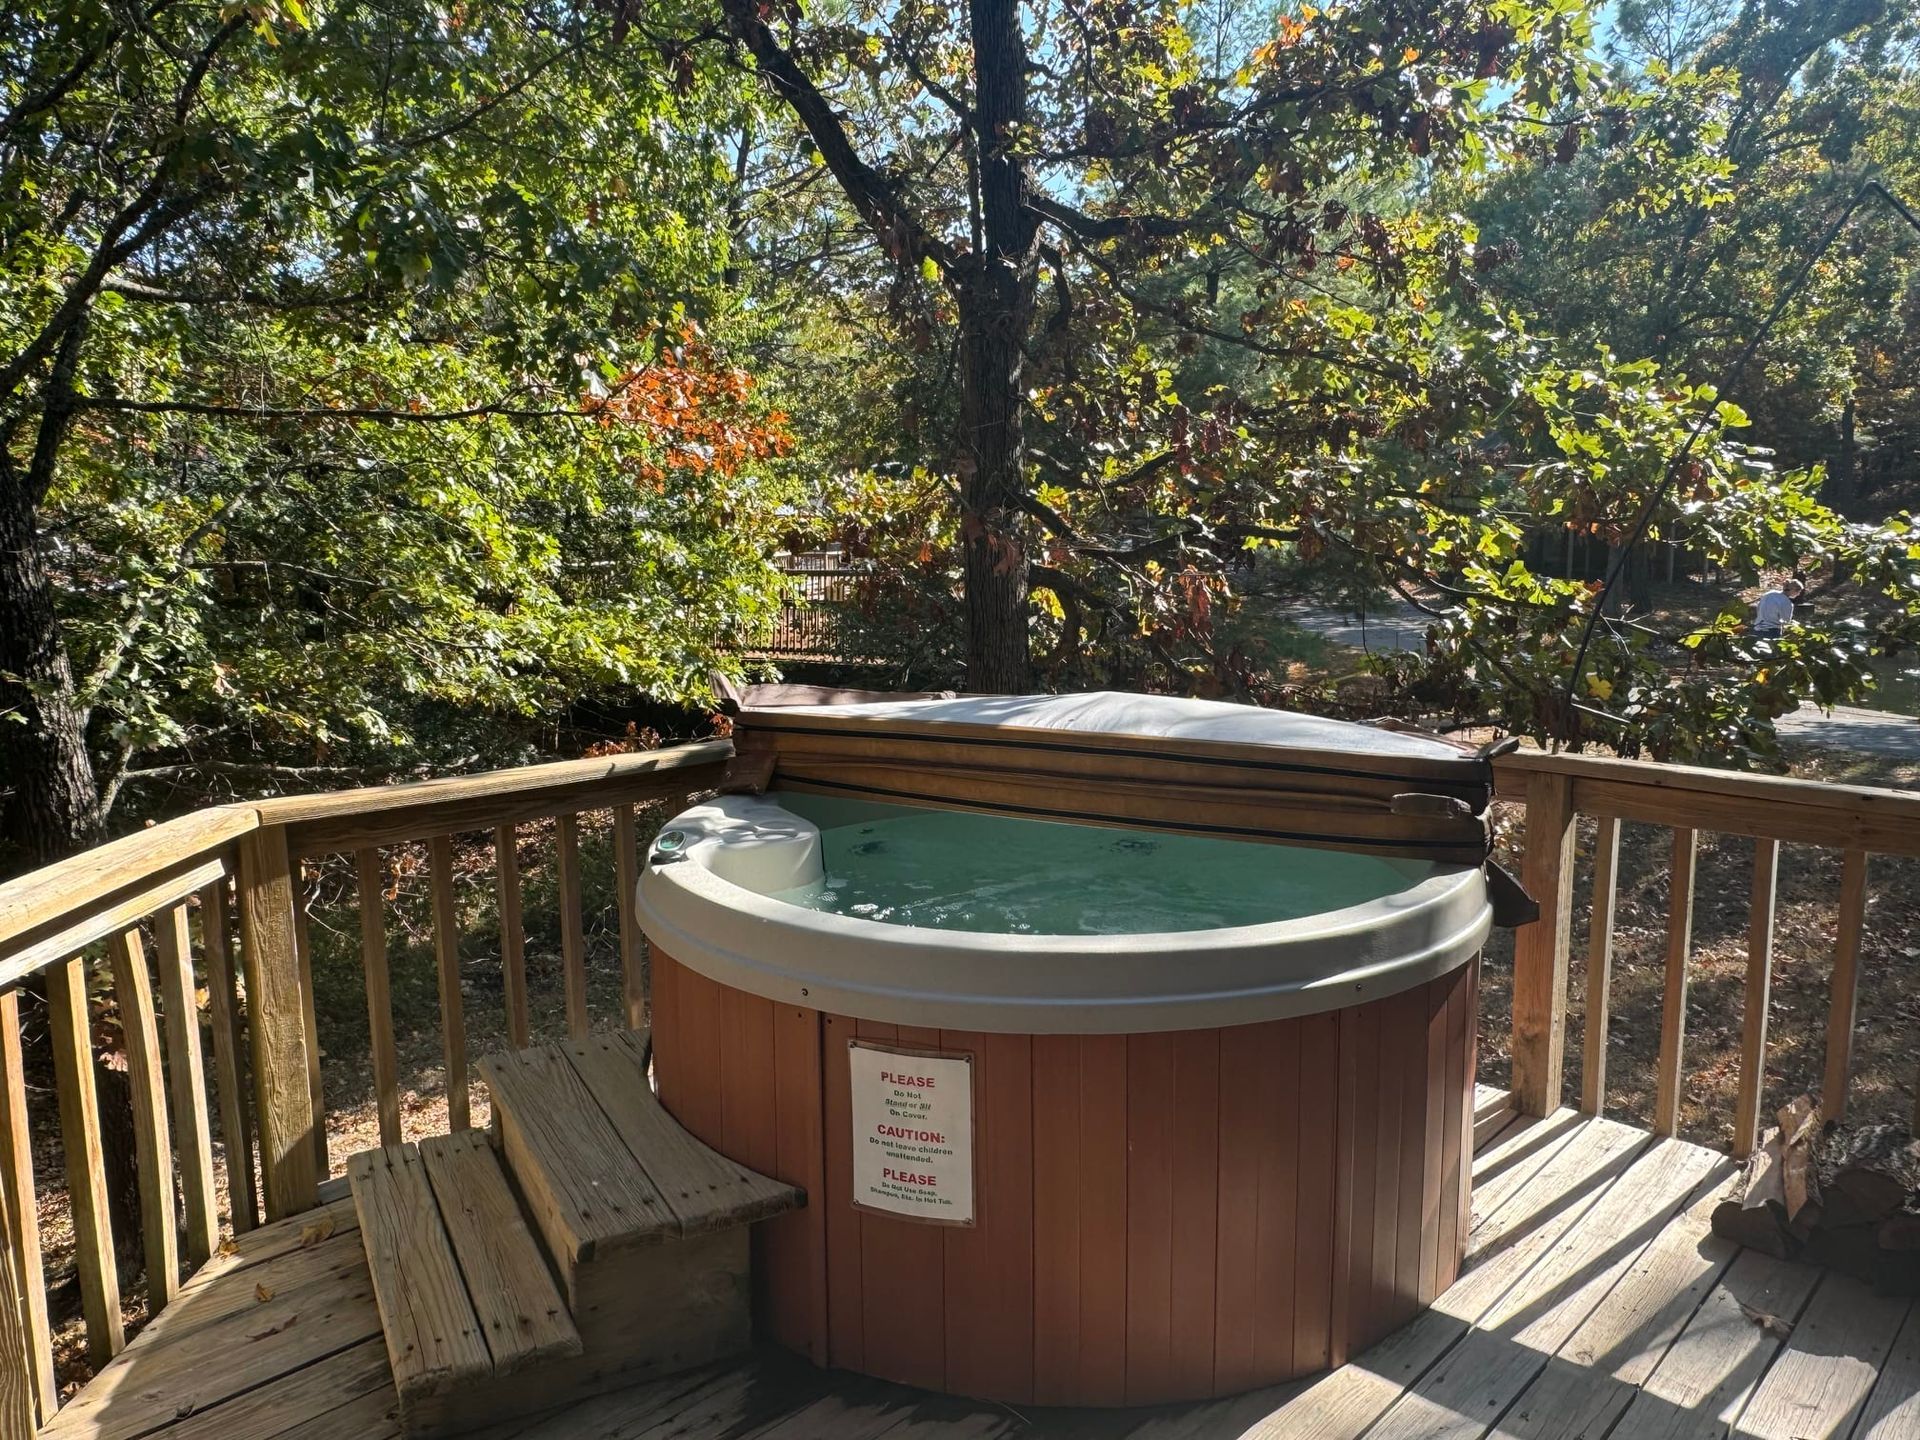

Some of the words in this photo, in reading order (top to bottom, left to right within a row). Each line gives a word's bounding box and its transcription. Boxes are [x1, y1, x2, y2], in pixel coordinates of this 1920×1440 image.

[881, 1072, 935, 1088] PLEASE
[885, 1099, 908, 1108] Stand
[903, 1111, 927, 1119] Cover.
[877, 1124, 945, 1143] CAUTION:
[896, 1142, 916, 1151] leave
[919, 1147, 952, 1155] children
[886, 1151, 933, 1163] unattended.
[883, 1168, 936, 1186] PLEASE
